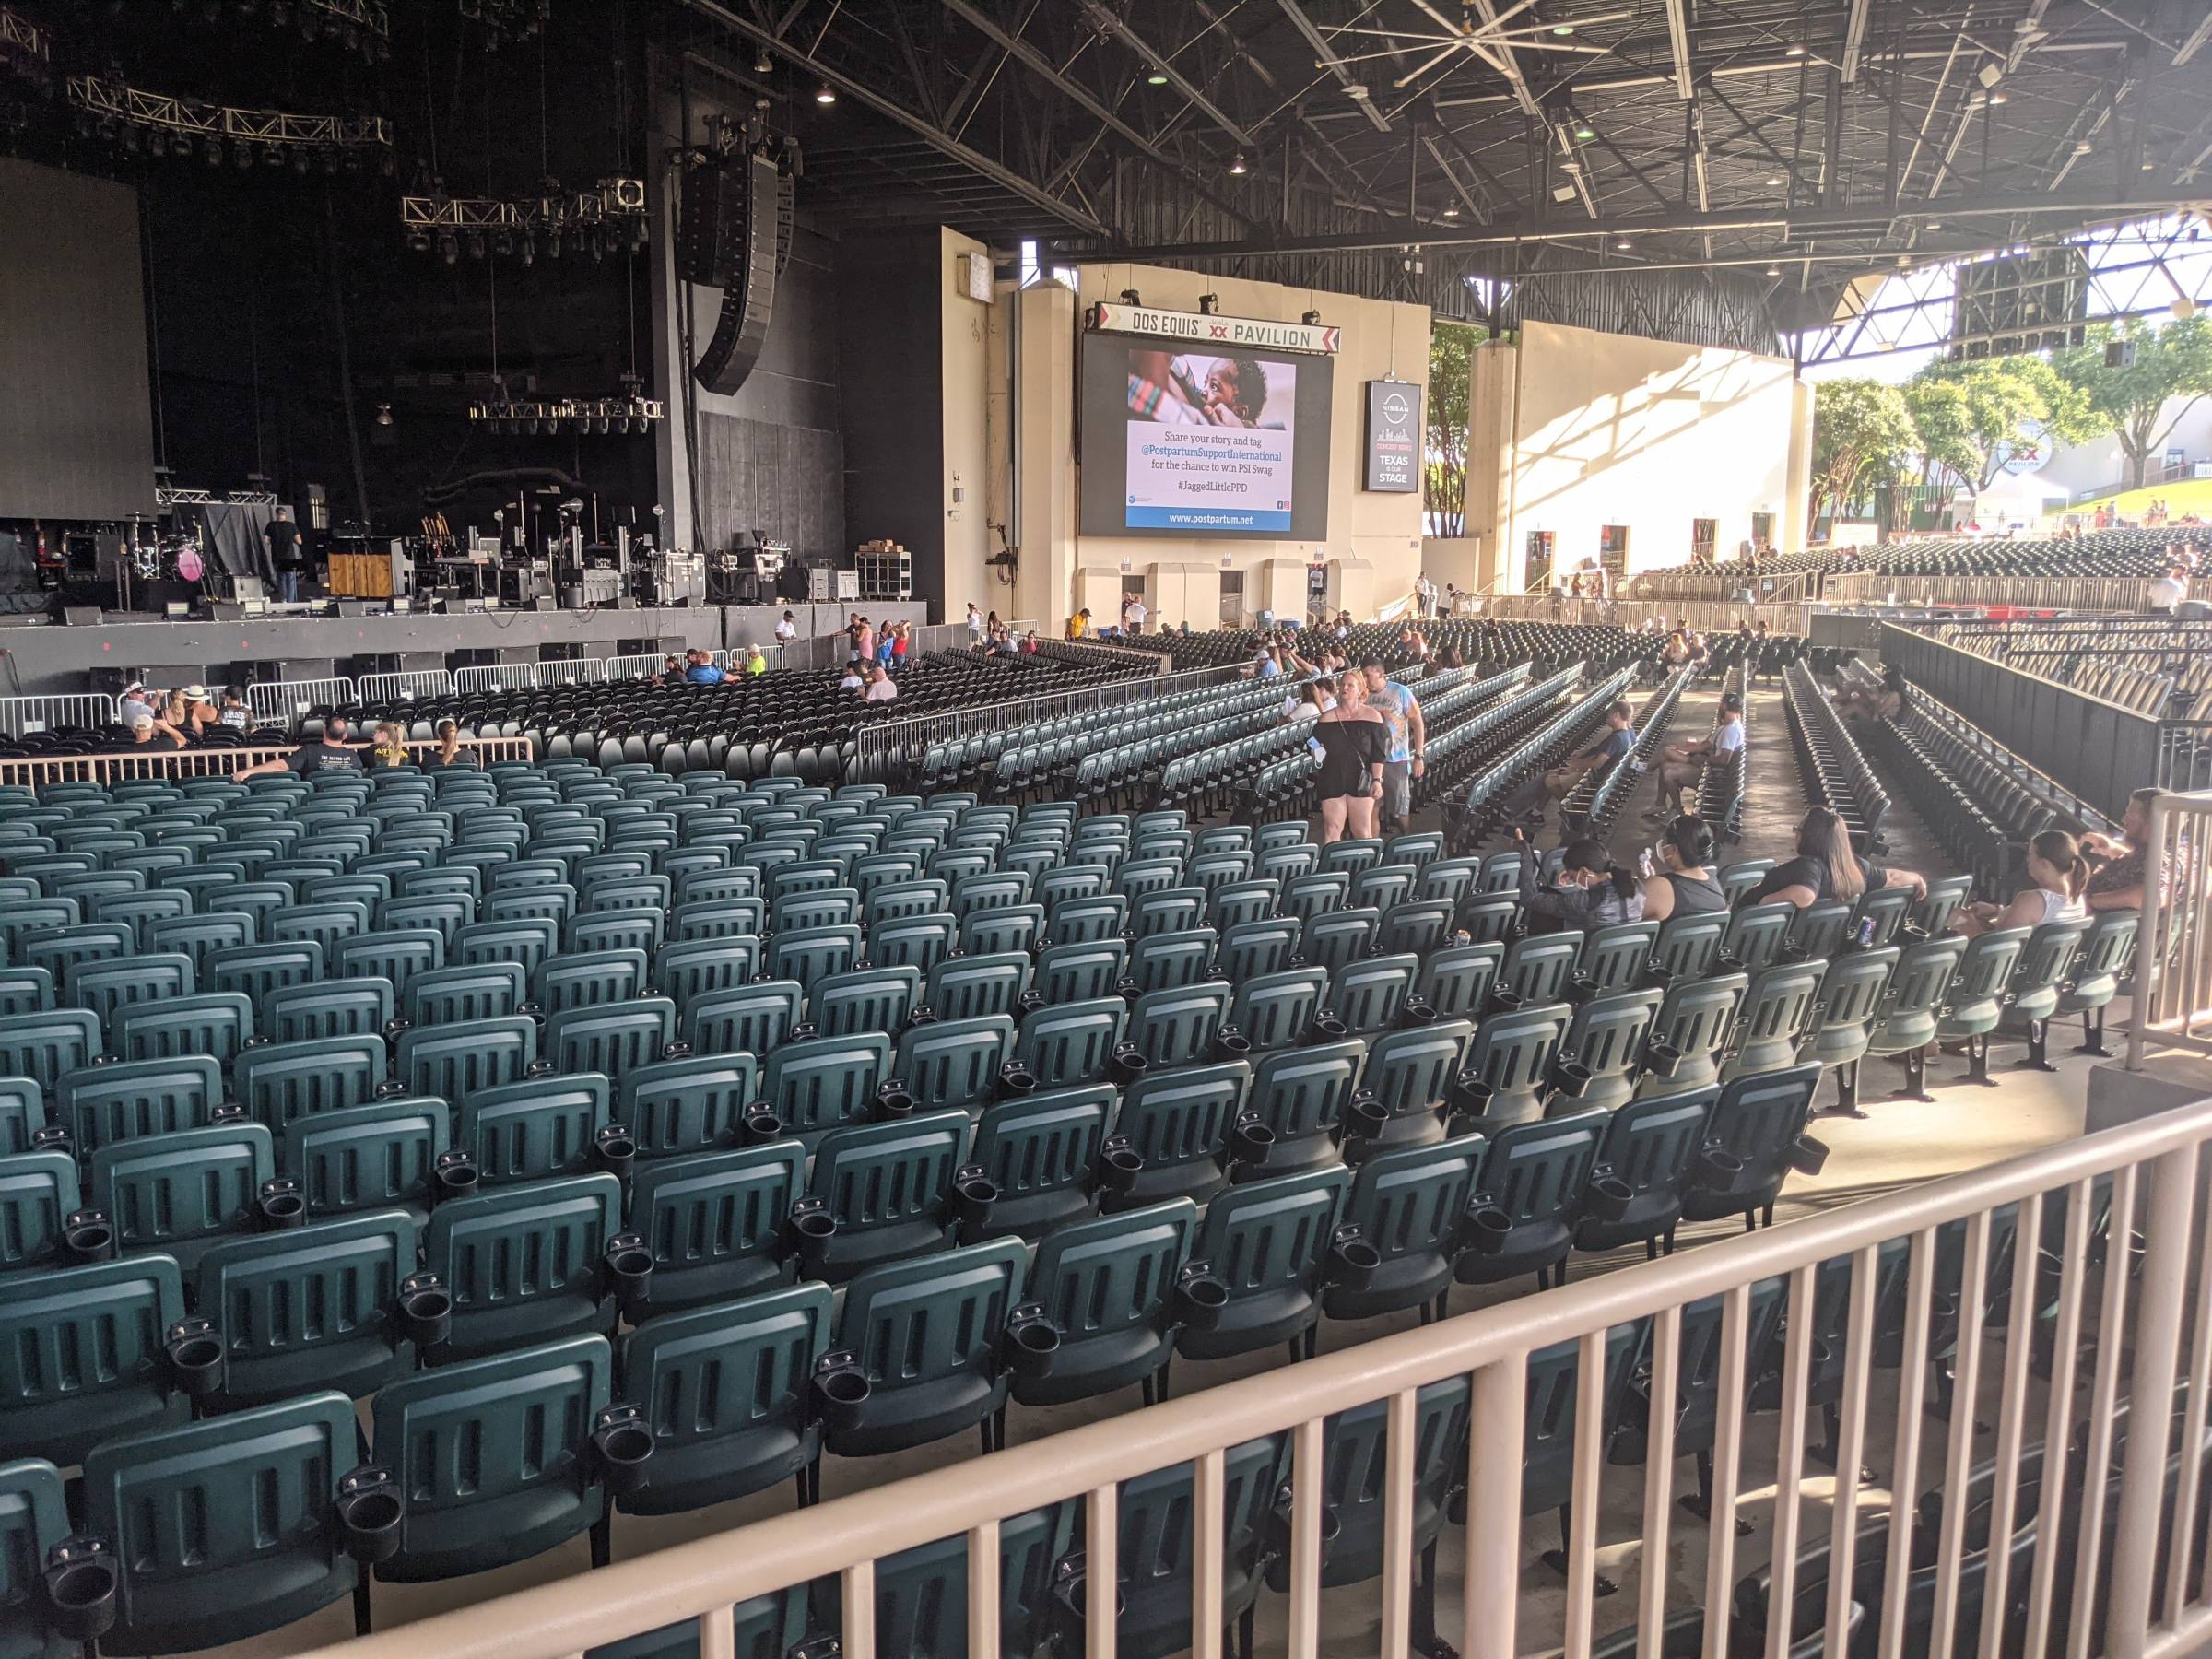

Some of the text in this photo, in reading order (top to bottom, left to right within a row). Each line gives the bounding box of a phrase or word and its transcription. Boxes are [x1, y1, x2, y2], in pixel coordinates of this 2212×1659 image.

[1133, 312, 1311, 347] DOS EQUIS XX PAVILION
[1165, 431, 1262, 448] Share your story and tag
[1141, 444, 1282, 461] @PostpartumSupportInternational
[1379, 455, 1408, 465] TEXAS
[1151, 459, 1273, 477] for the chance to win PSI Swag
[1379, 473, 1407, 483] STAGE
[1178, 480, 1248, 493] #JaggedLittlePPD
[1169, 513, 1253, 524] www.postpartum.net
